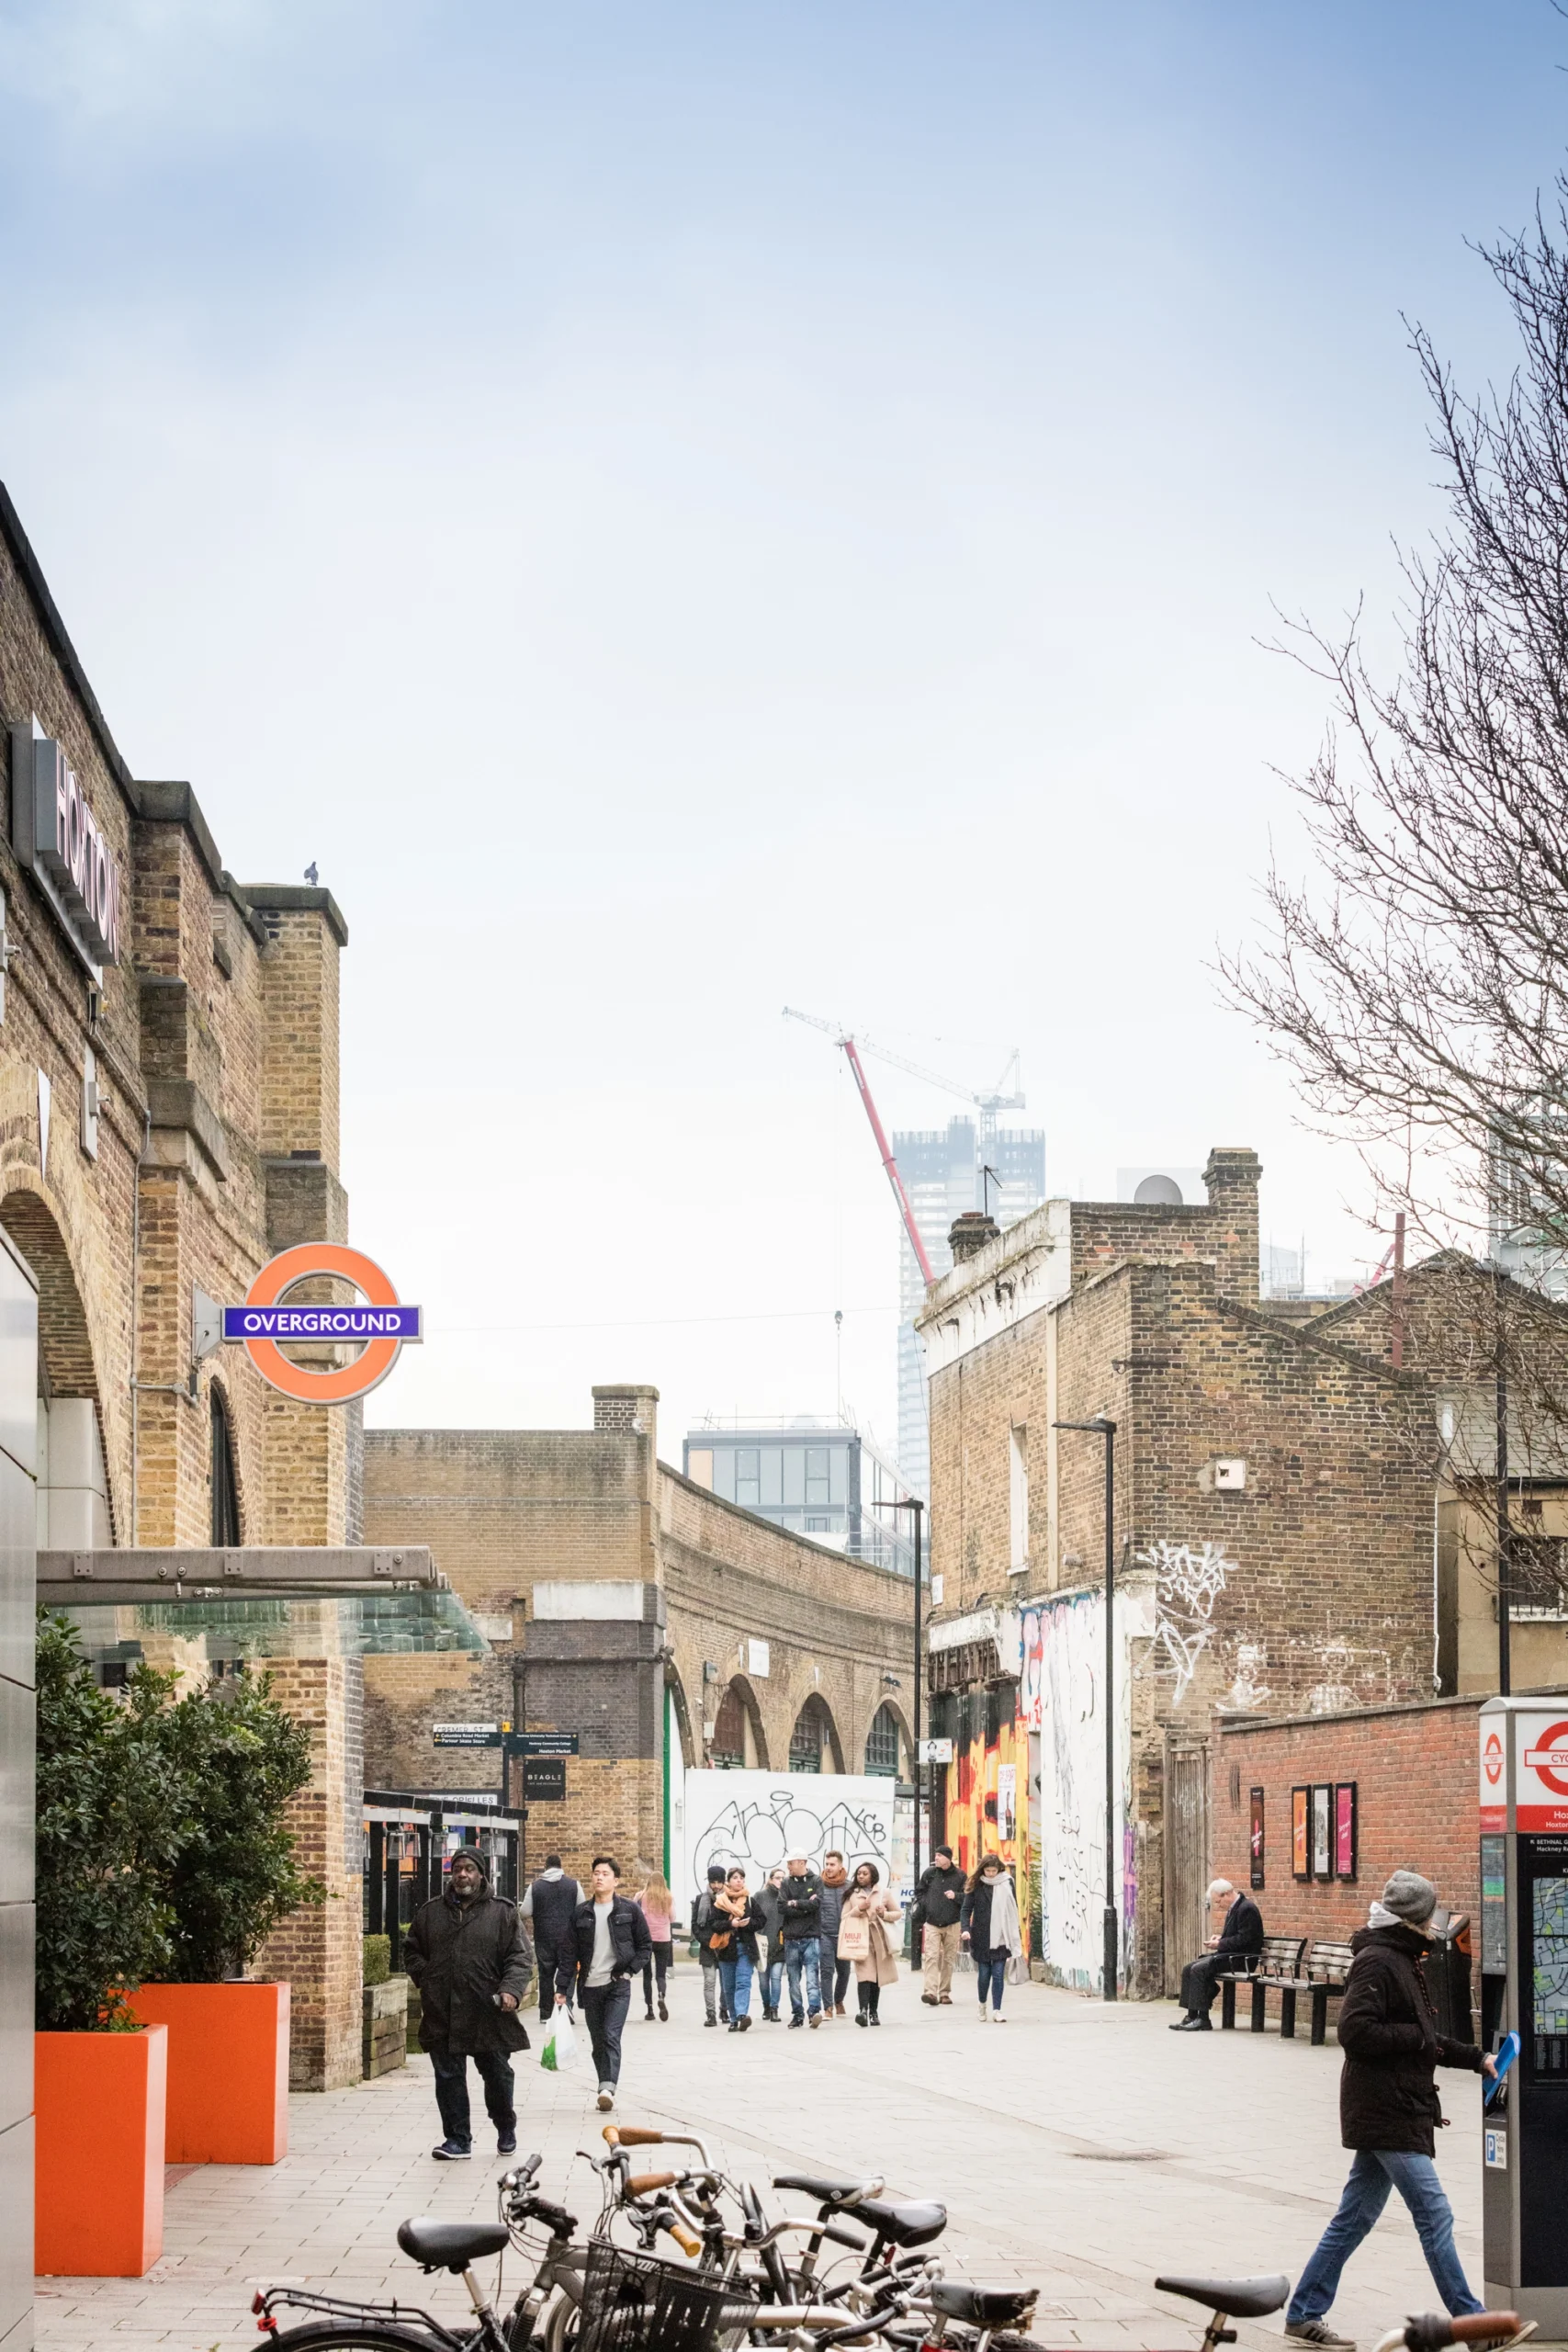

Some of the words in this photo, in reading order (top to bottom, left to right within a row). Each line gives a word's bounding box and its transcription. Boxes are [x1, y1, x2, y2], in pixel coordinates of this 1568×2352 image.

[56, 739, 119, 967] HOXTON
[243, 1314, 400, 1331] OVERGROUND
[1496, 2132, 1506, 2143] Cycle
[1488, 2137, 1495, 2160] P
